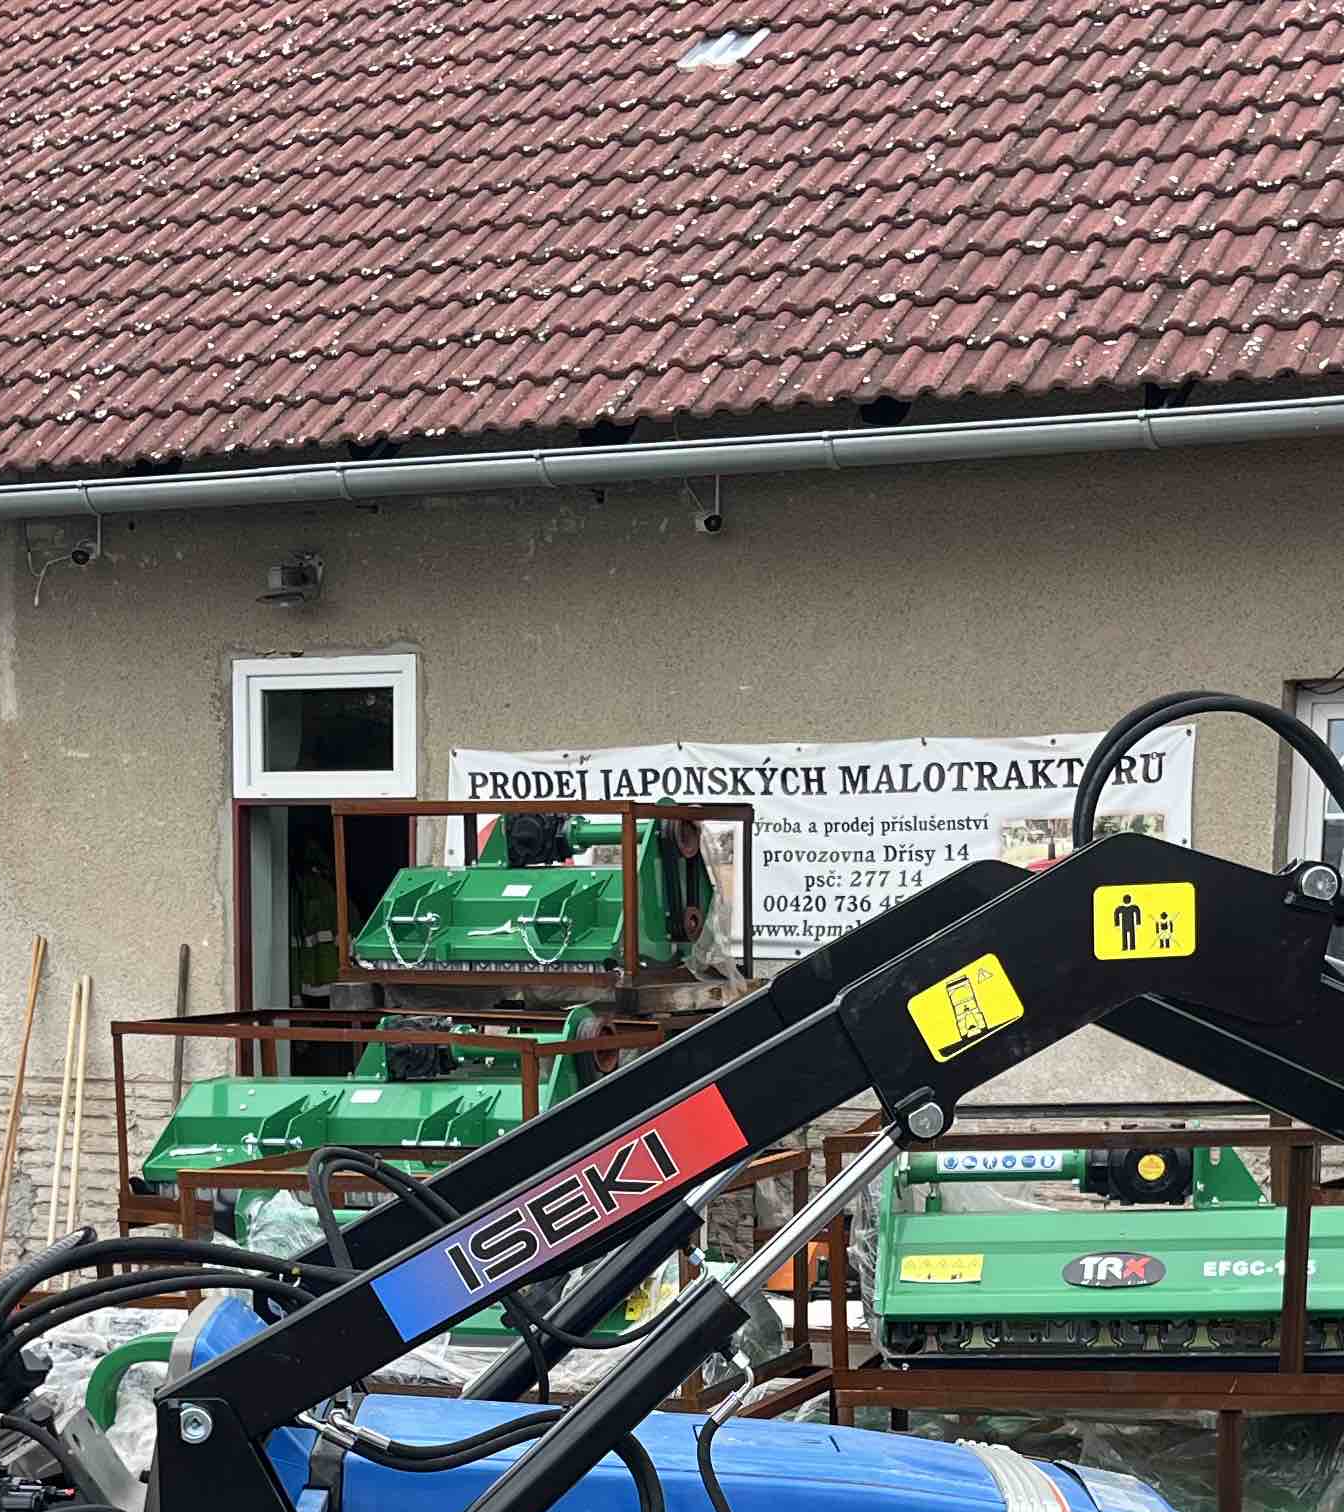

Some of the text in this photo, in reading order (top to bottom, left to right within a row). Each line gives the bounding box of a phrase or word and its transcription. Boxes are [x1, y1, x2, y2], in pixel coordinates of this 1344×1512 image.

[468, 751, 1167, 800] PRODEJ JAPONSKÝCH MALOTRAKTRŮ
[752, 814, 990, 836] ýroba a prodej příslušenství
[763, 844, 970, 867] provozovna Dřísy 14
[805, 870, 923, 891] psč: 277 14
[763, 895, 905, 913] 00420 736 45
[752, 920, 862, 940] www.kpma
[444, 1128, 680, 1295] ISEKI
[1079, 1256, 1151, 1281] TRX
[1202, 1259, 1317, 1277] EFGC-15
